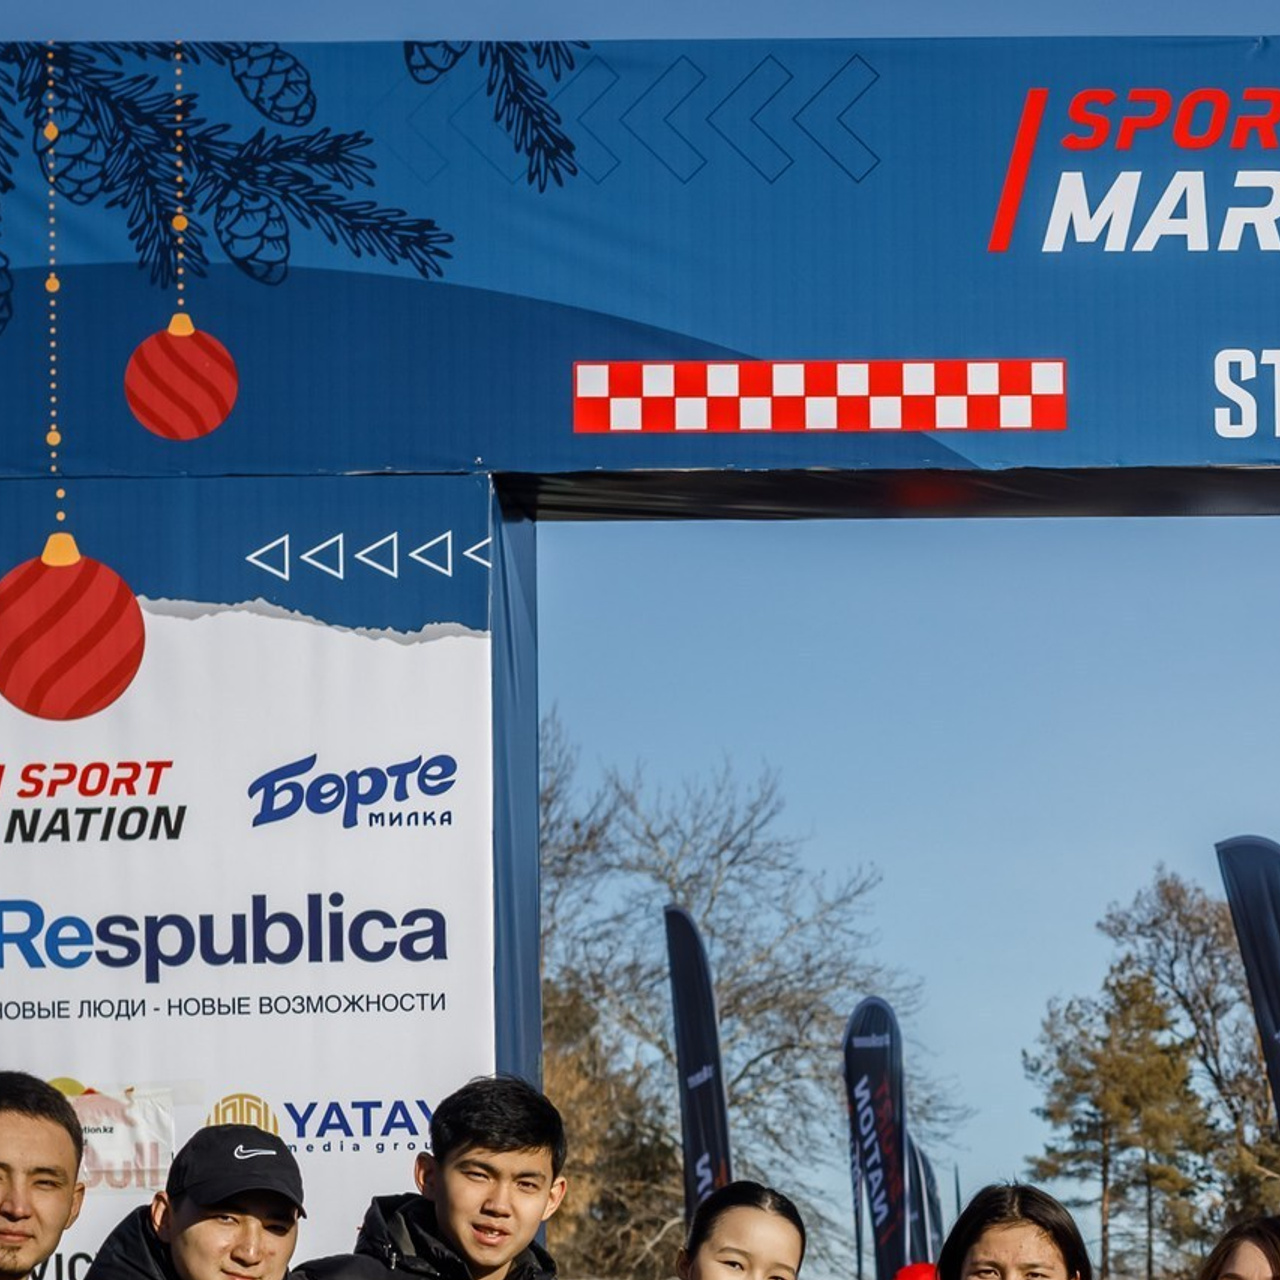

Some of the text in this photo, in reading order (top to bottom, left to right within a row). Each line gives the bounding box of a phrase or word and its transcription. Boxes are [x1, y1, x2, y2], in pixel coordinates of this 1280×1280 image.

[16, 761, 173, 798] SPORT
[4, 805, 187, 843] NATION
[0, 892, 447, 983] Respublica
[0, 1000, 70, 1020] ОВЫЕ
[78, 999, 147, 1021] ЛЮДИ
[167, 997, 251, 1017] НОВЫЕ
[259, 993, 447, 1015] ВОЗМОЖНОСТИ
[376, 1141, 432, 1153] grou
